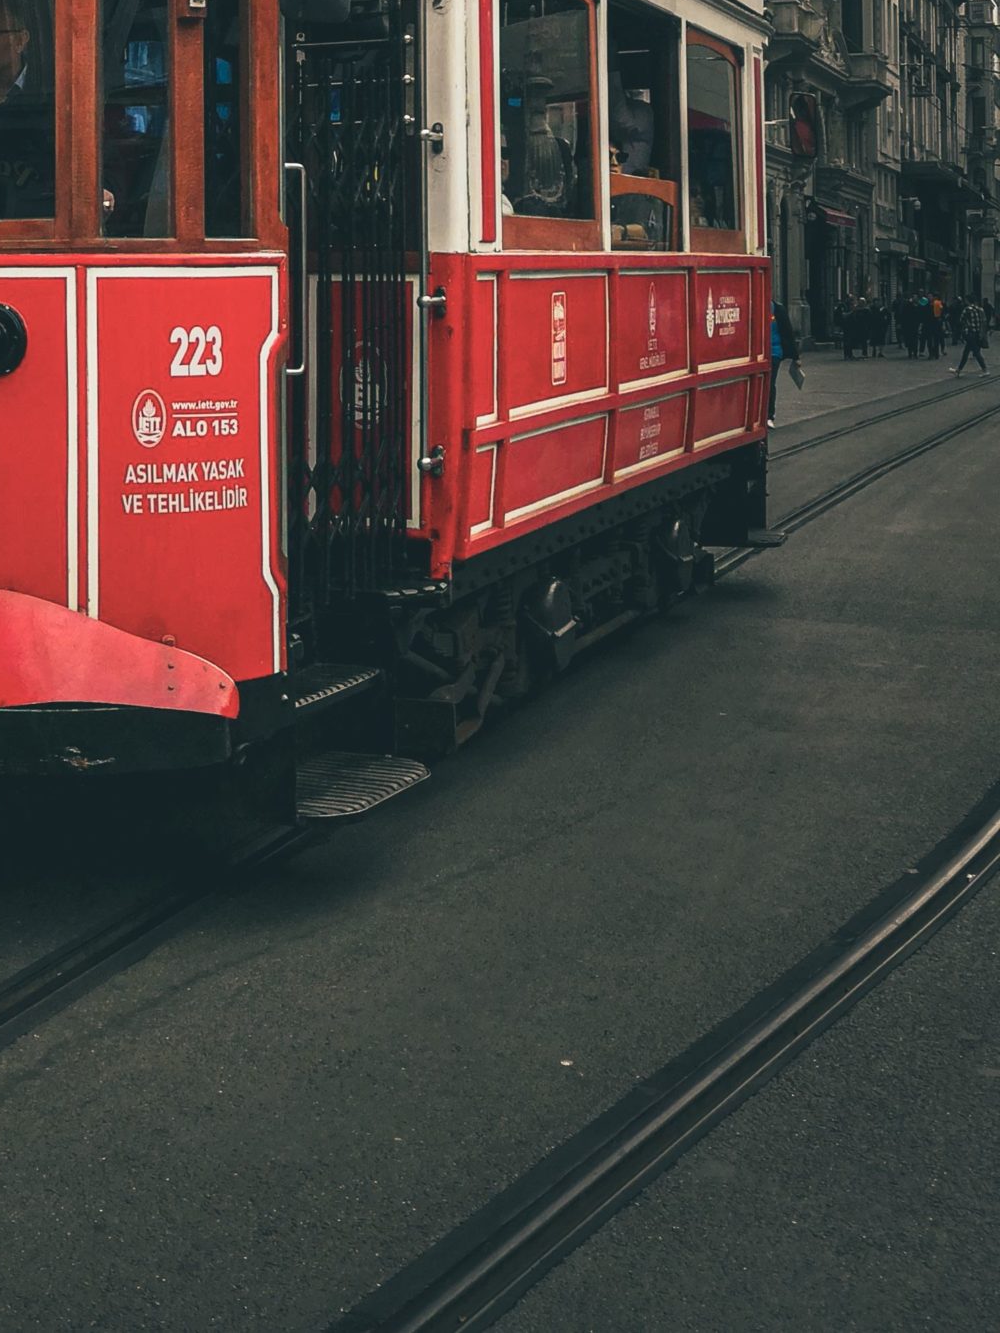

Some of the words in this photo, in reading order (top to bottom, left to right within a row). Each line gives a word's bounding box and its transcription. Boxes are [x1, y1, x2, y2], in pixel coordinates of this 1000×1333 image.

[169, 325, 223, 377] 223
[172, 399, 238, 412] www.iett.gov.tr
[172, 420, 208, 437] ALO
[212, 418, 239, 436] 153
[125, 462, 199, 485] ASILMAK
[201, 458, 245, 481] YASAK
[122, 494, 143, 514] VE
[147, 484, 248, 514] TEHLİKELİDİR
